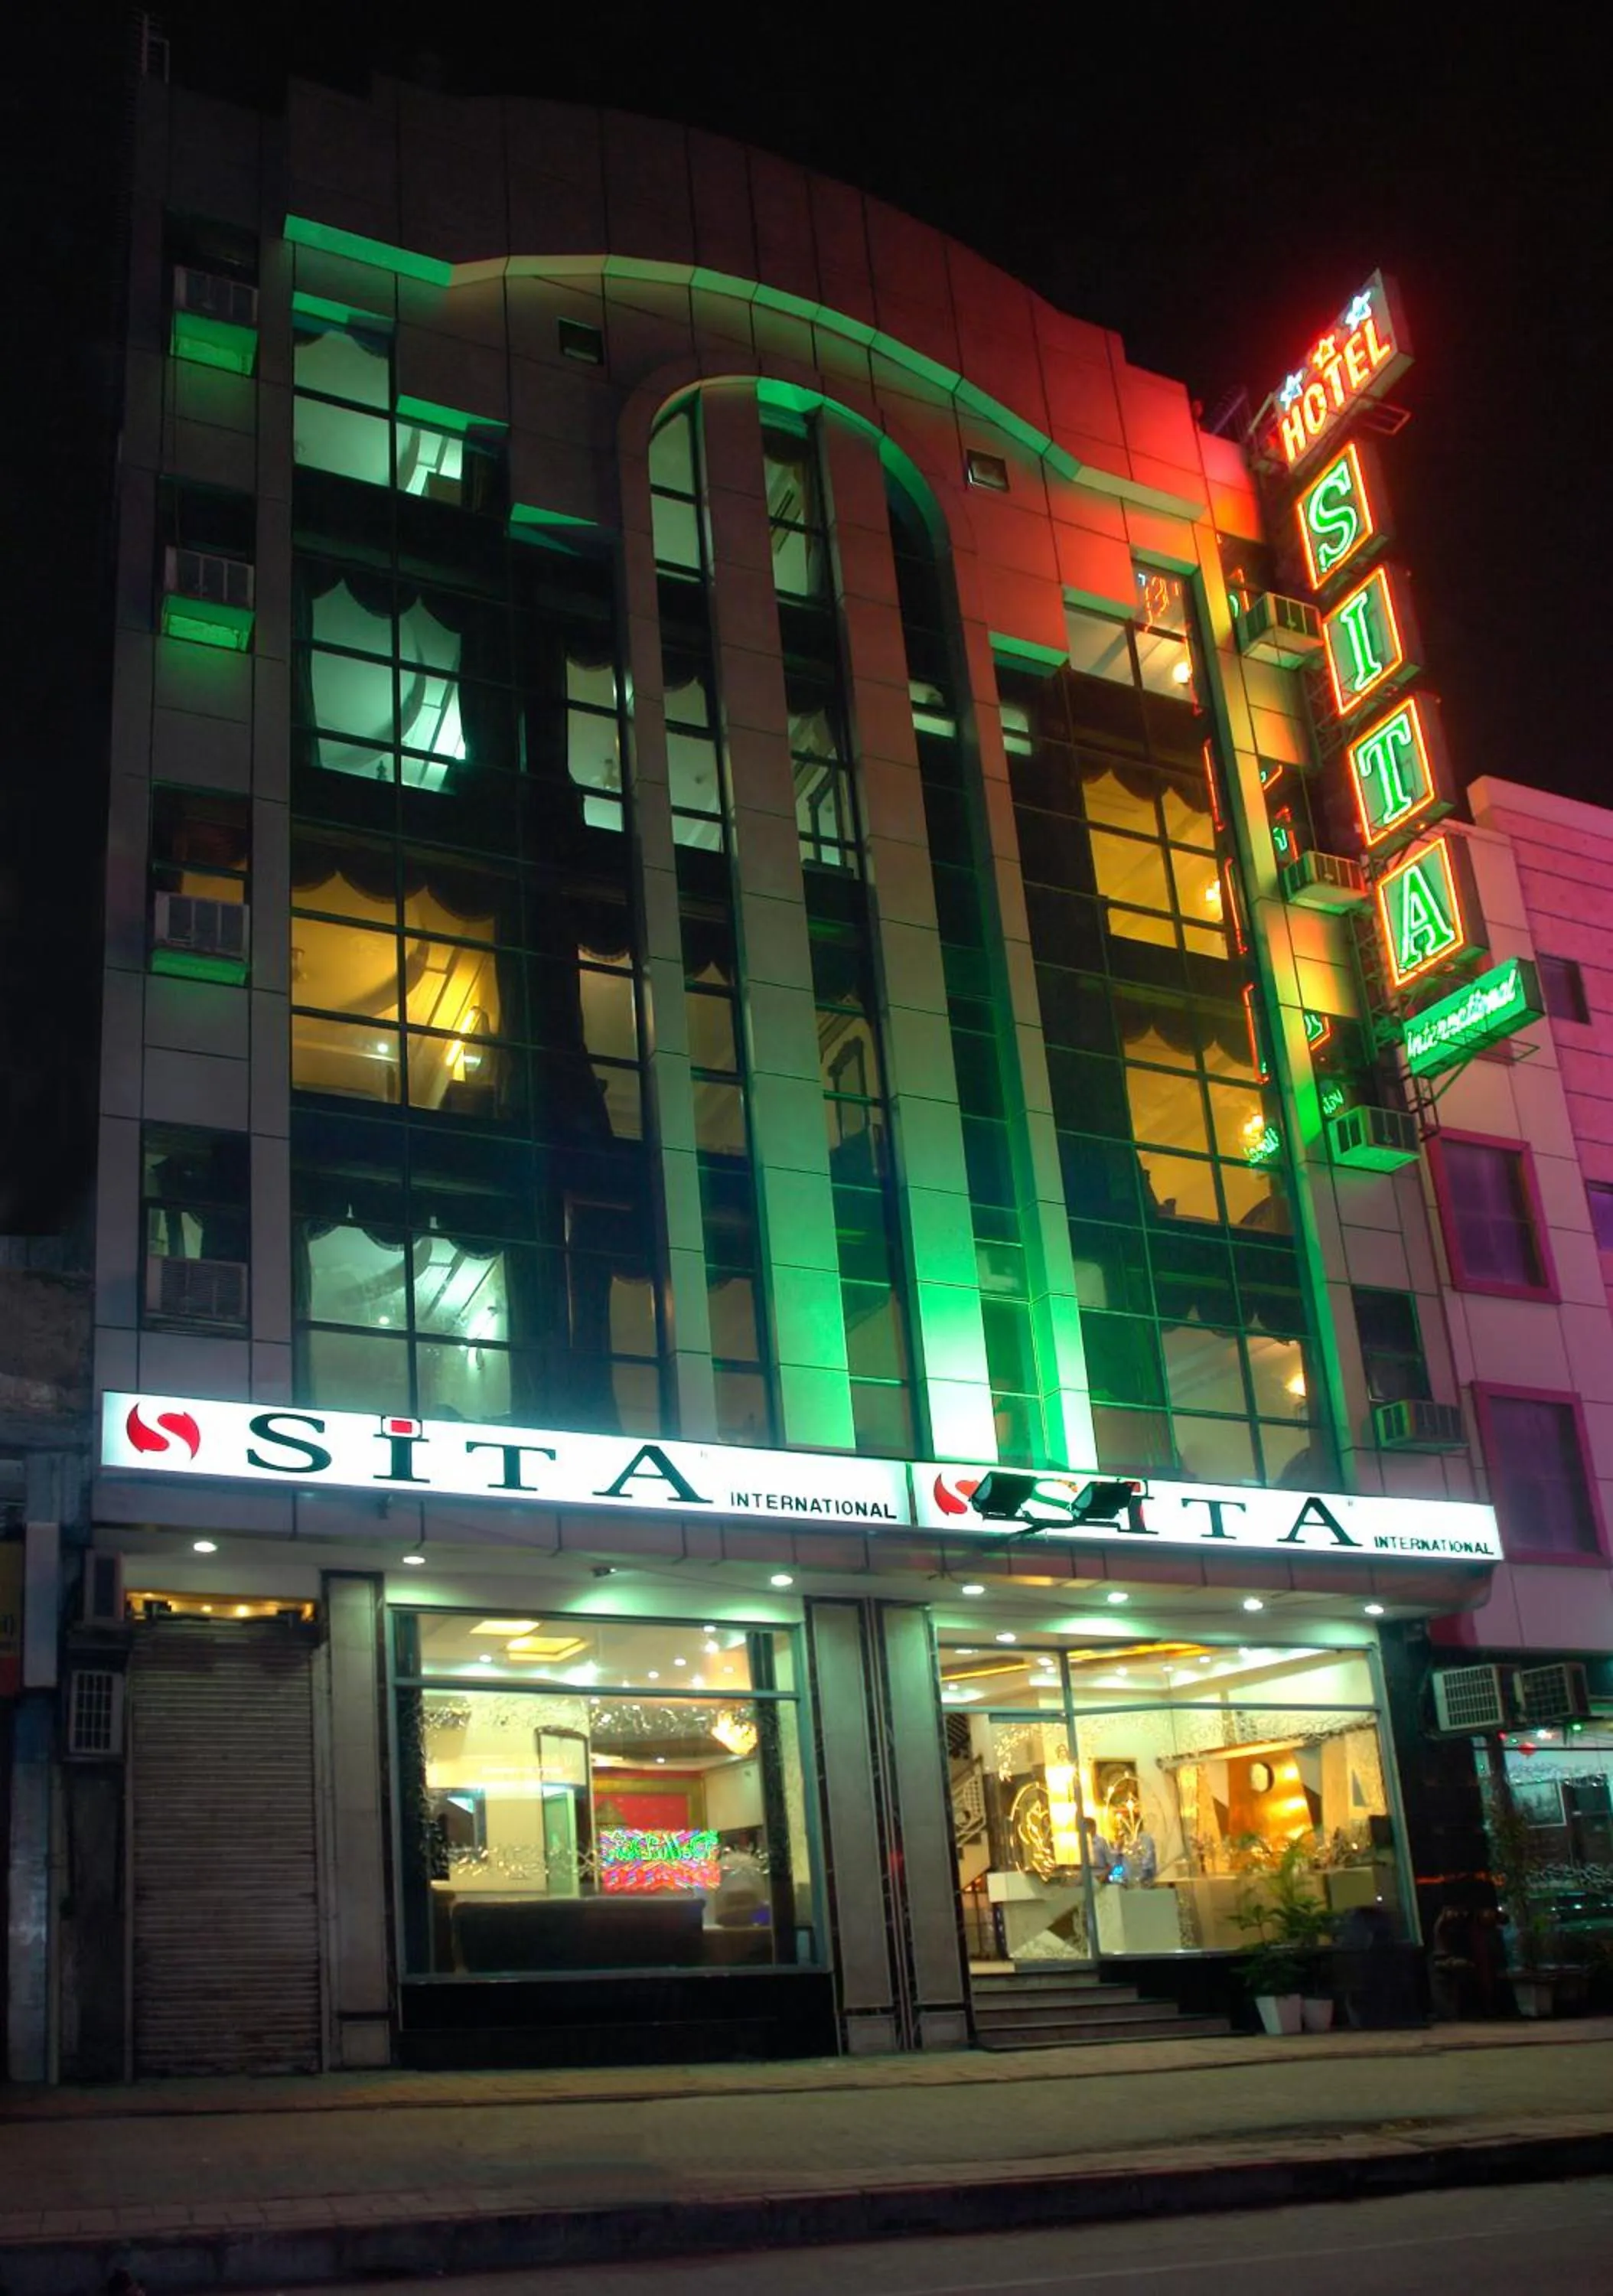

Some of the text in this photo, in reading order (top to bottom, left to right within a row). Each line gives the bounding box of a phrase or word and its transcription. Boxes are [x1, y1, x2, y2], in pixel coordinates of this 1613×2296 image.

[1281, 318, 1391, 464] HOTEL
[1308, 459, 1455, 975] SITA
[730, 1491, 898, 1520] INTERNATIONAL
[1373, 1535, 1494, 1555] INTERNATIONAL
